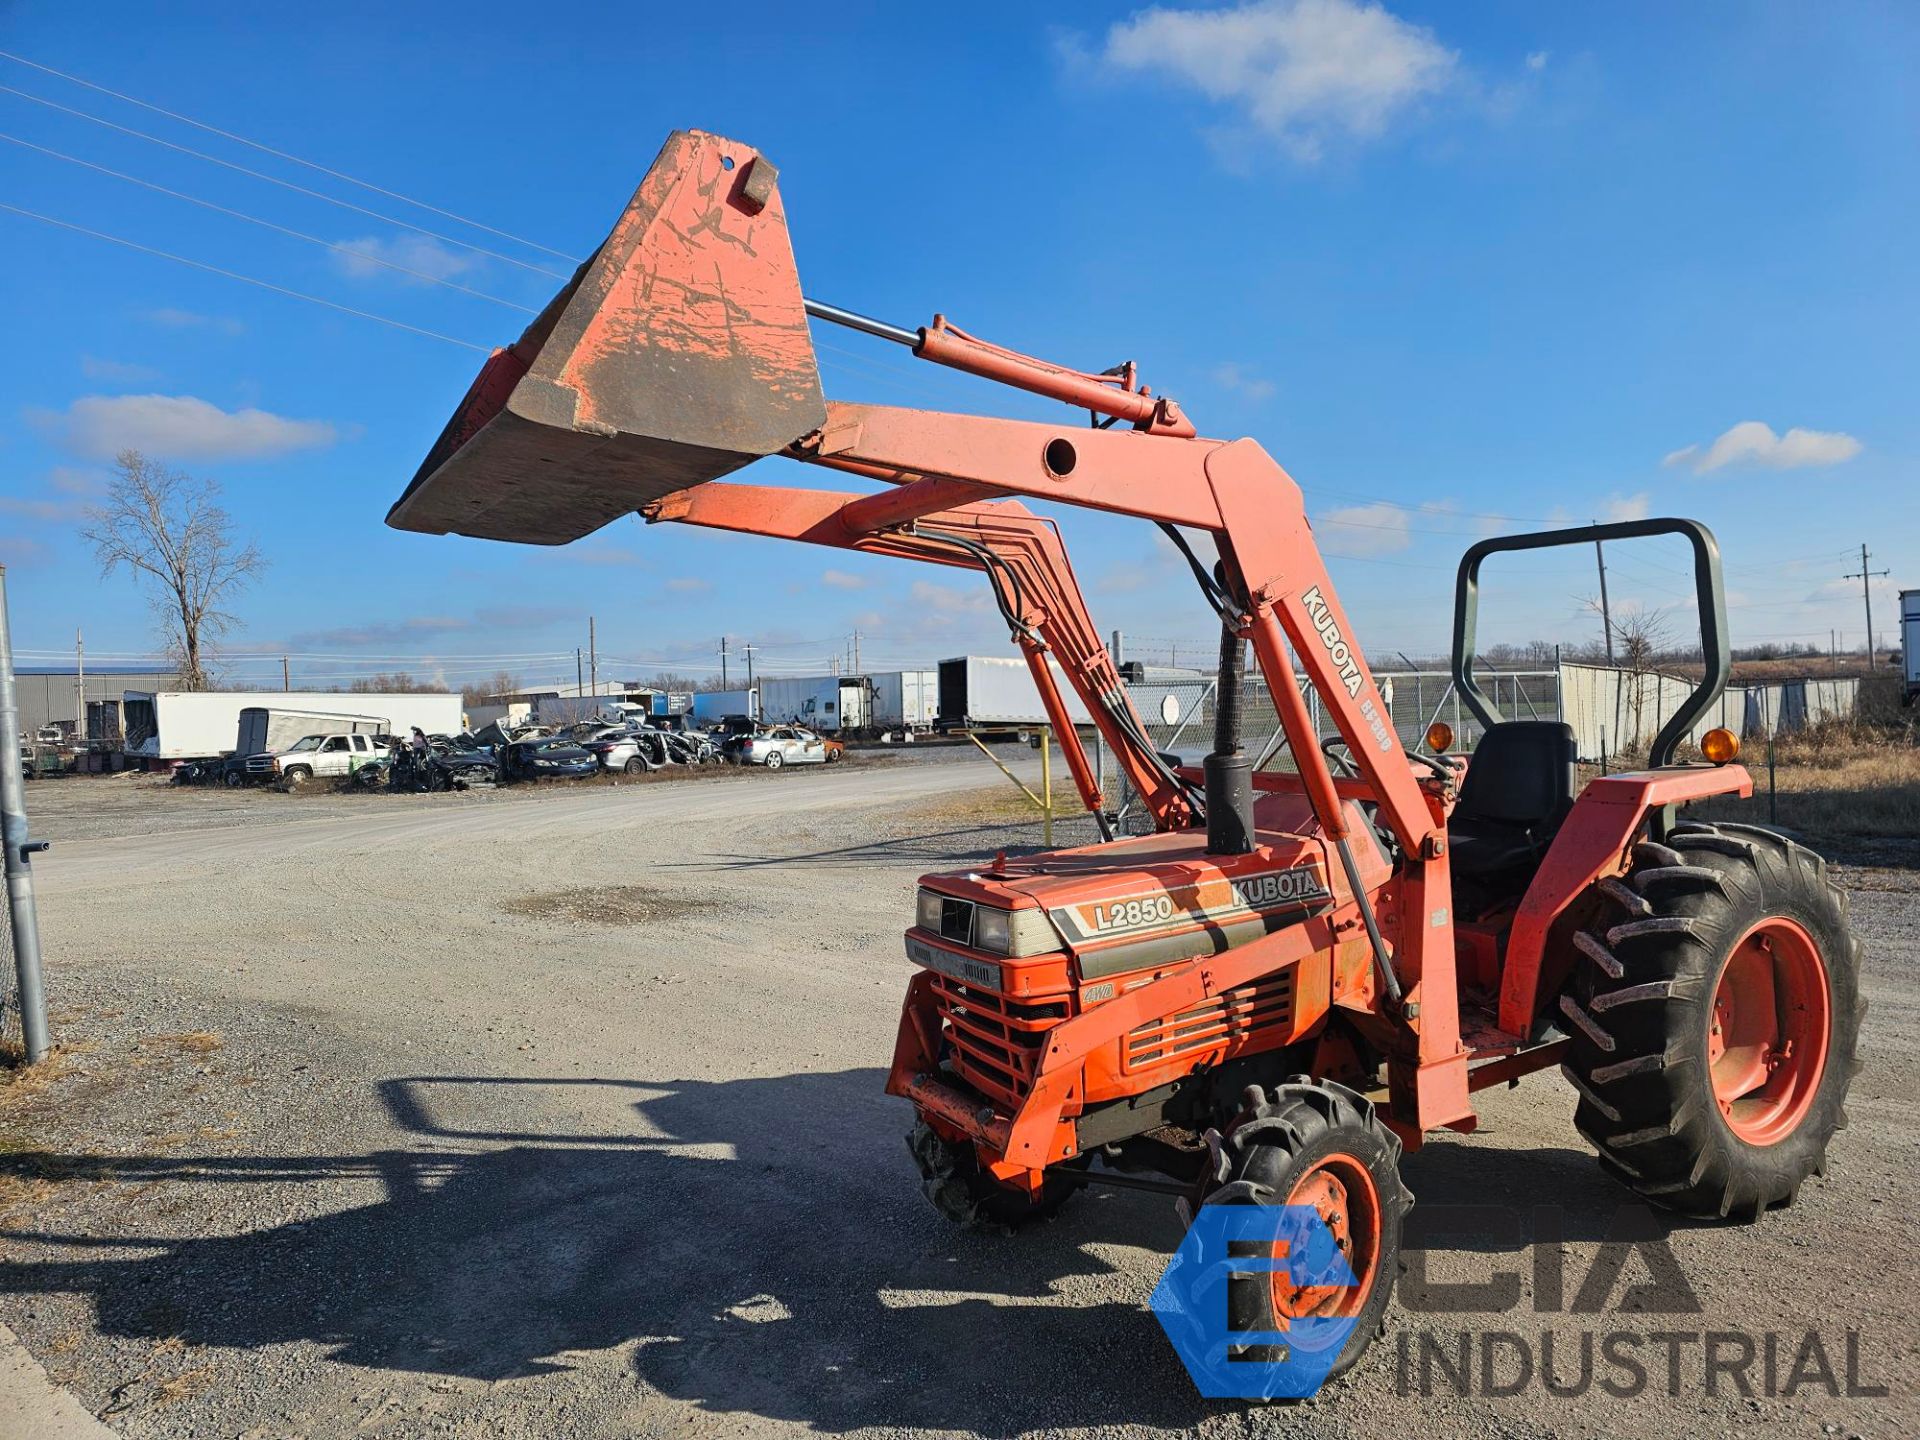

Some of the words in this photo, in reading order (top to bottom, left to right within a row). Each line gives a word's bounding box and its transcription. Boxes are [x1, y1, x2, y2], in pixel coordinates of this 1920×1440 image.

[1302, 585, 1364, 699] KUBOTA
[1232, 871, 1320, 907] KUBOTA
[1094, 895, 1173, 932] L2850
